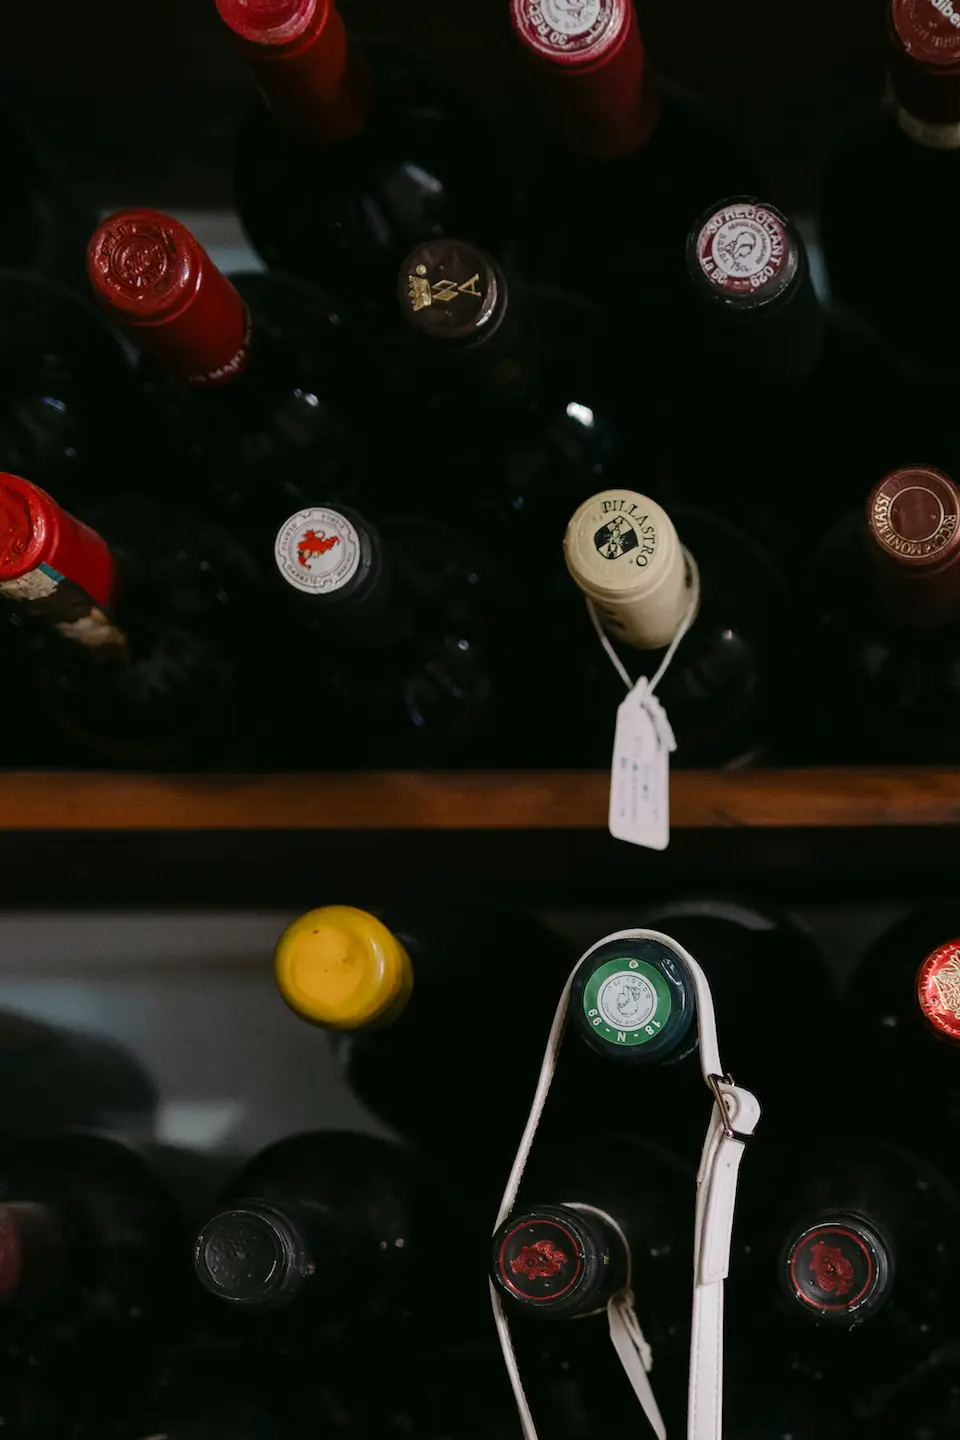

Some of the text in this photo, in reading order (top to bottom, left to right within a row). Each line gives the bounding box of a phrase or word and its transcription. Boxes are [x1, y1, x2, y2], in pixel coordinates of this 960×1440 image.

[750, 265, 774, 288] 029
[601, 499, 657, 568] PILLASTRO
[874, 491, 923, 555] MONTEMASSI
[588, 1008, 661, 1042] 18 N 99
